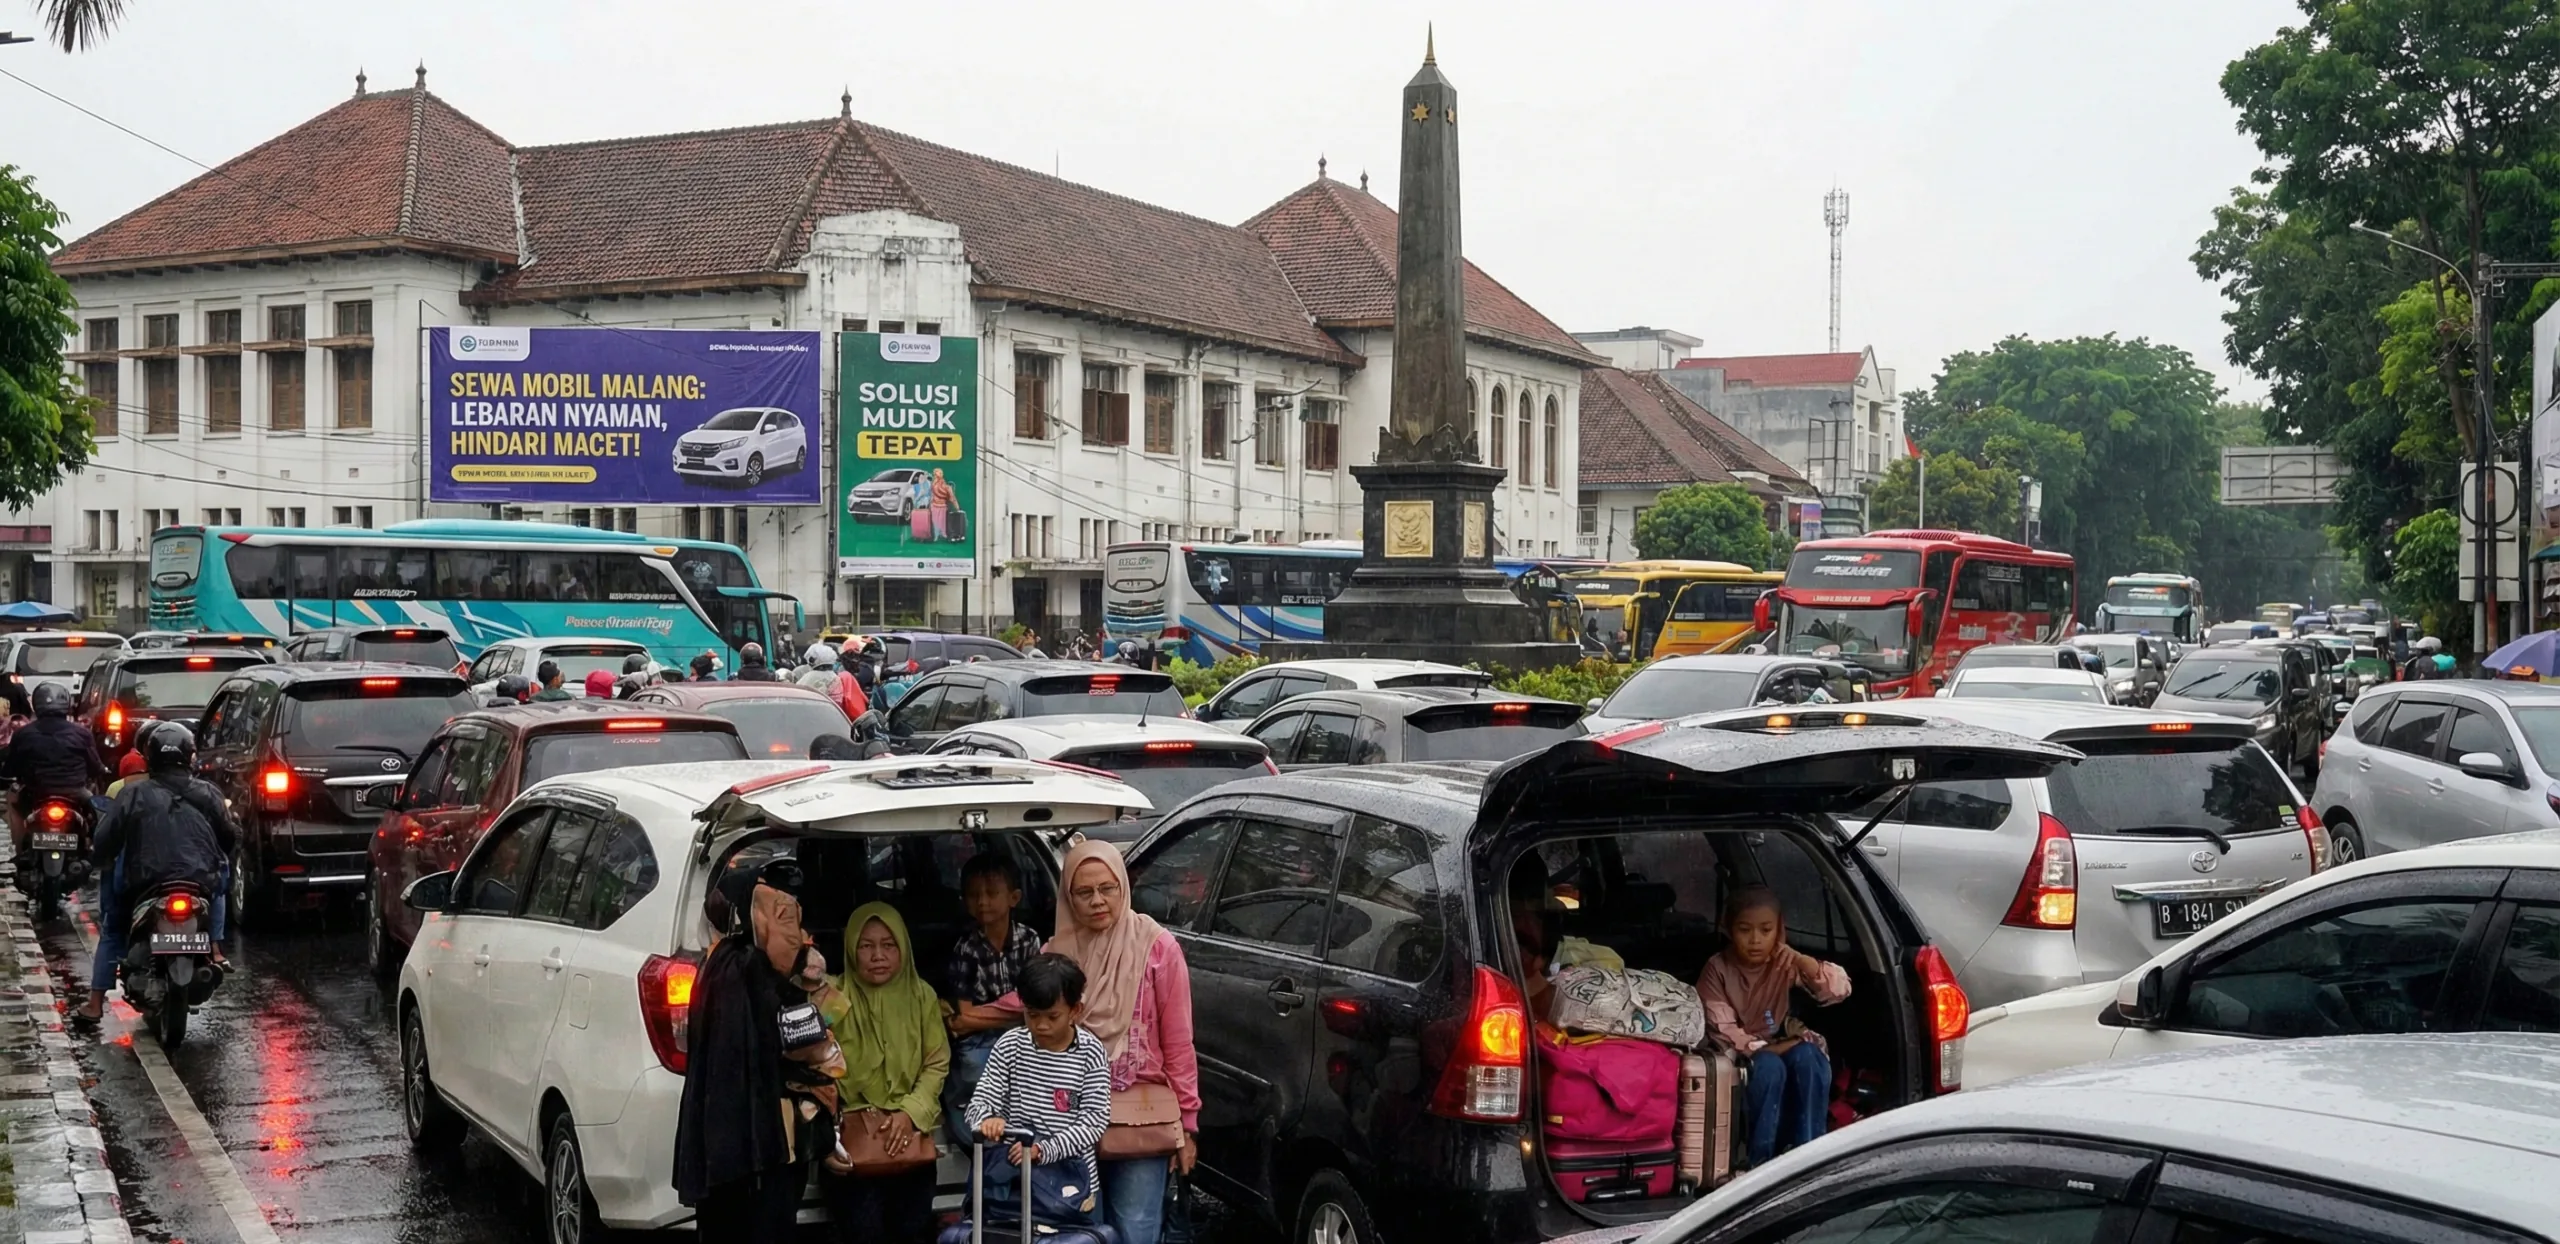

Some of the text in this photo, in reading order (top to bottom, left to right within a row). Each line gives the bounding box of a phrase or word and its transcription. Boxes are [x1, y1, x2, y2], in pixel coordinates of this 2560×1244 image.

[450, 372, 706, 400] SEWA MOBIL MALANG:
[859, 382, 958, 406] SOLUSI
[451, 402, 668, 432] LEBARAN NYAMAN,
[862, 407, 956, 430] MUDIK
[451, 431, 640, 457] HINDARI MACET!
[866, 435, 953, 456] TEPAT
[2162, 904, 2171, 924] B
[2184, 902, 2214, 922] 1841
